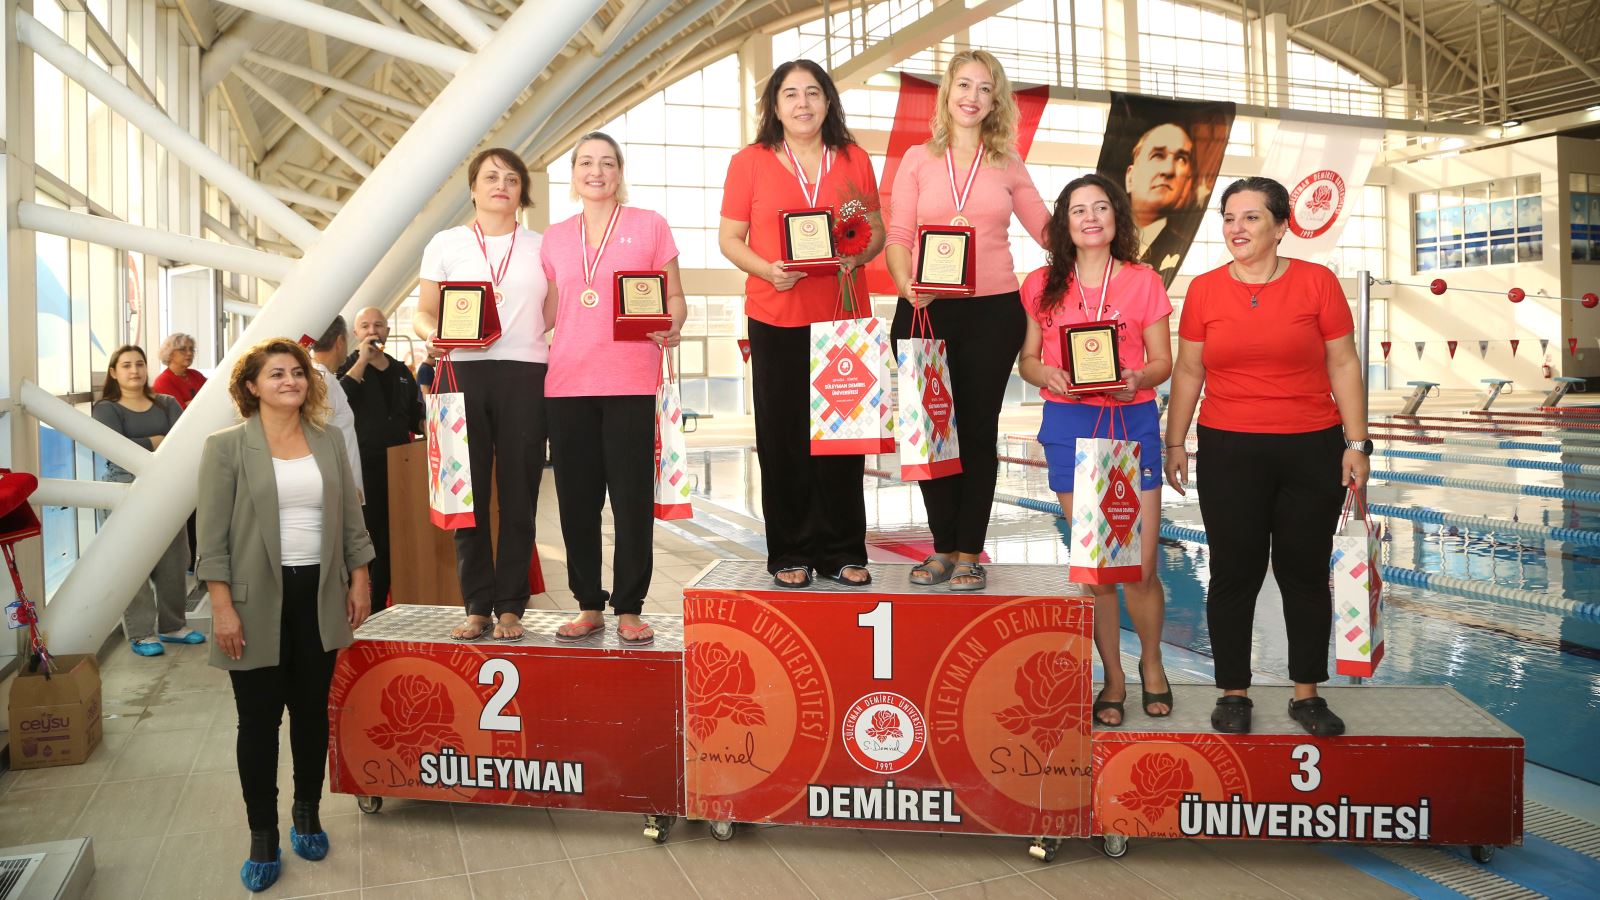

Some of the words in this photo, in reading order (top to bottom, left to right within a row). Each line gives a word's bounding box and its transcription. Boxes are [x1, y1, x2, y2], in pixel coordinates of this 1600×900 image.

[857, 600, 894, 680] 1
[477, 657, 522, 732] 2
[751, 608, 825, 742] ÜNİVERSİTESİ
[931, 636, 988, 745] SÜLEYMAN
[20, 715, 70, 733] ceysu
[844, 706, 863, 741] SÜLEYMAN
[864, 693, 895, 707] DEMİREL
[898, 697, 924, 743] ÜNİVERSİTESİ
[419, 748, 584, 794] SÜLEYMAN
[876, 761, 894, 771] 1992
[1290, 743, 1322, 792] 3
[807, 780, 962, 824] DEMİREL
[1179, 793, 1430, 840] ÜNİVERSİTESİ
